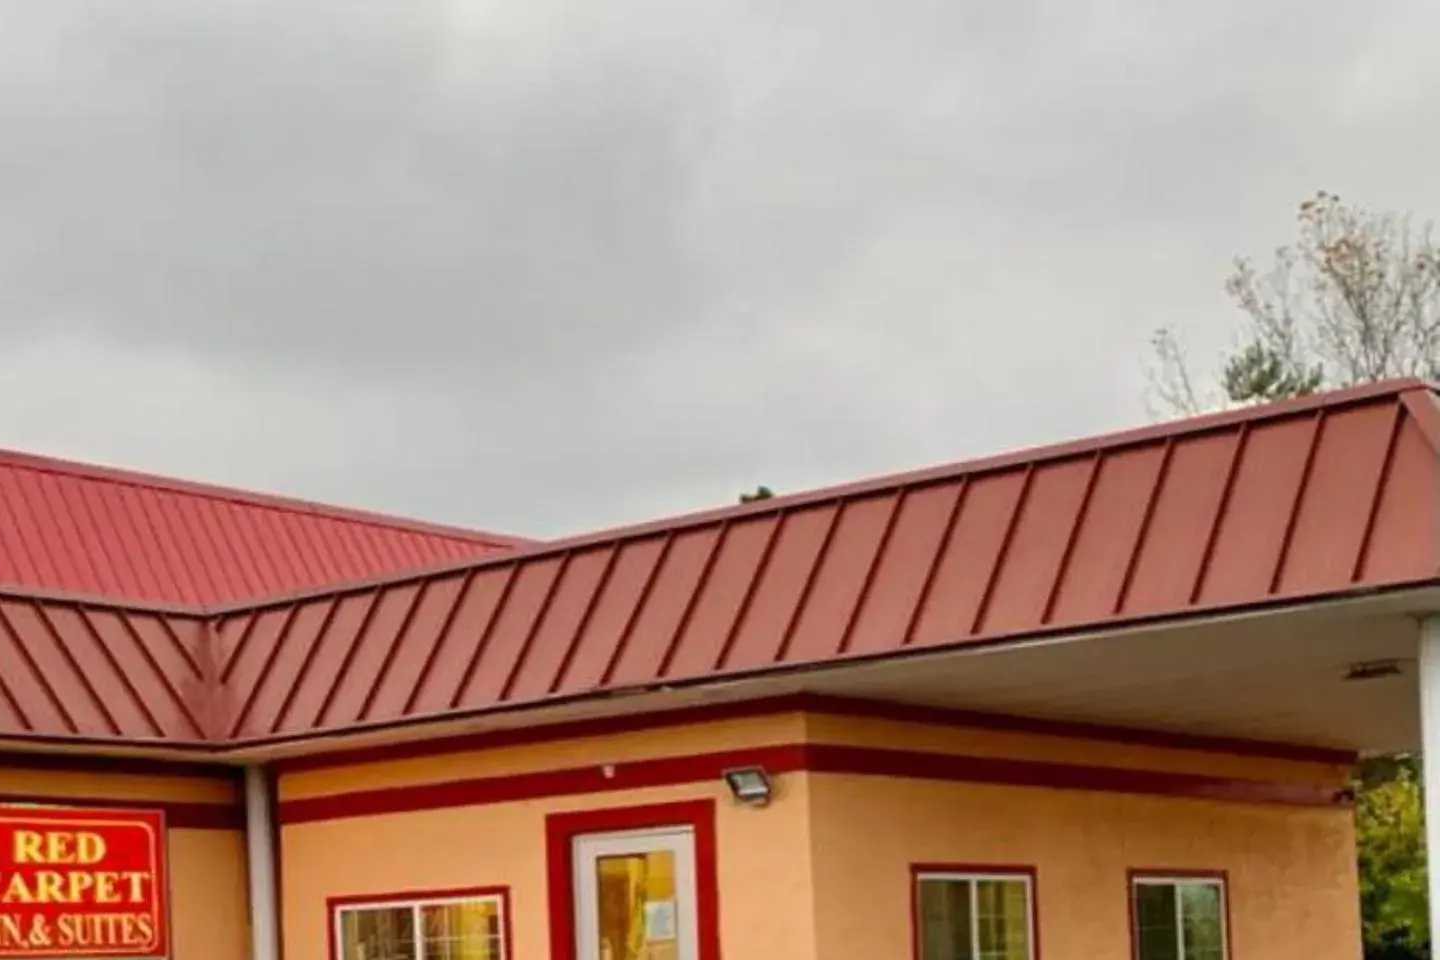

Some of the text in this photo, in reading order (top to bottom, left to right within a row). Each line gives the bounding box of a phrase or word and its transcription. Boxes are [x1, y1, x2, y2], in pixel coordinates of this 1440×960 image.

[13, 829, 106, 864] RED
[29, 913, 52, 946] &
[57, 911, 153, 947] SUITES
